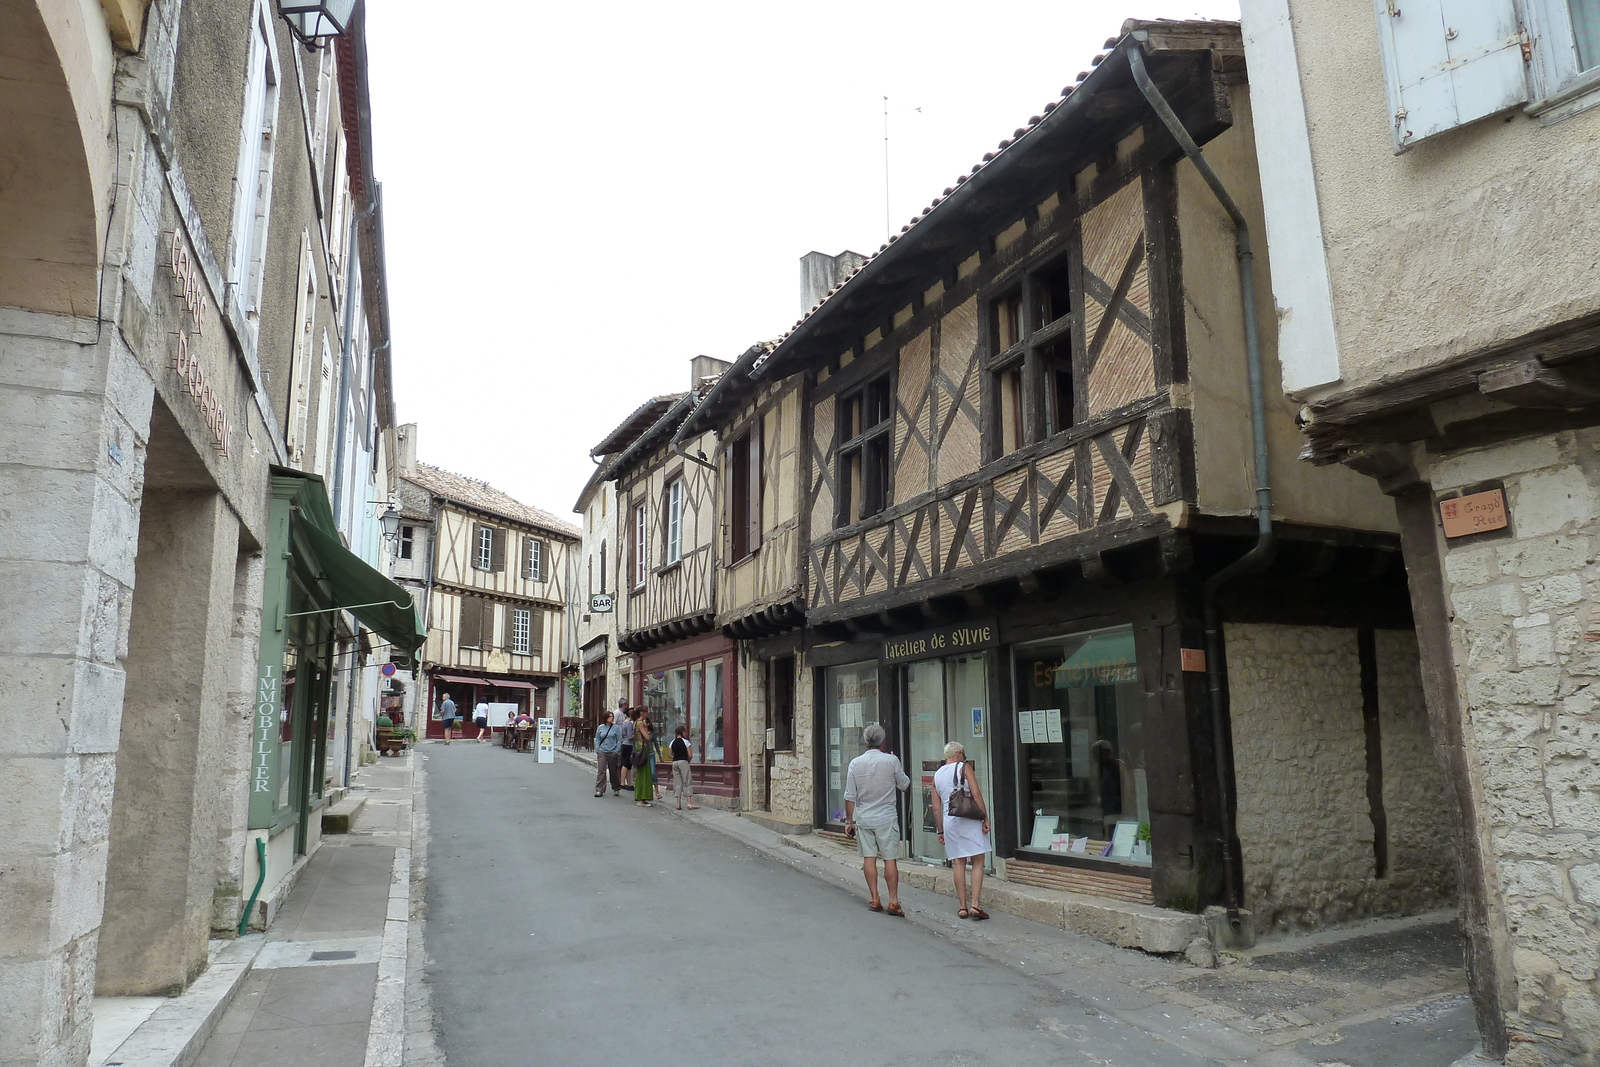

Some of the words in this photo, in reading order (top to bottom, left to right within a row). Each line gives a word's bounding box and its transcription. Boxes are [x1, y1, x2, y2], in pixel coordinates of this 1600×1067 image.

[172, 228, 206, 337] CAISSE
[1473, 515, 1503, 527] Rue
[593, 599, 611, 608] BAR
[930, 633, 946, 649] de
[837, 679, 878, 699] Ben-être
[254, 665, 277, 793] IMMOBILIER
